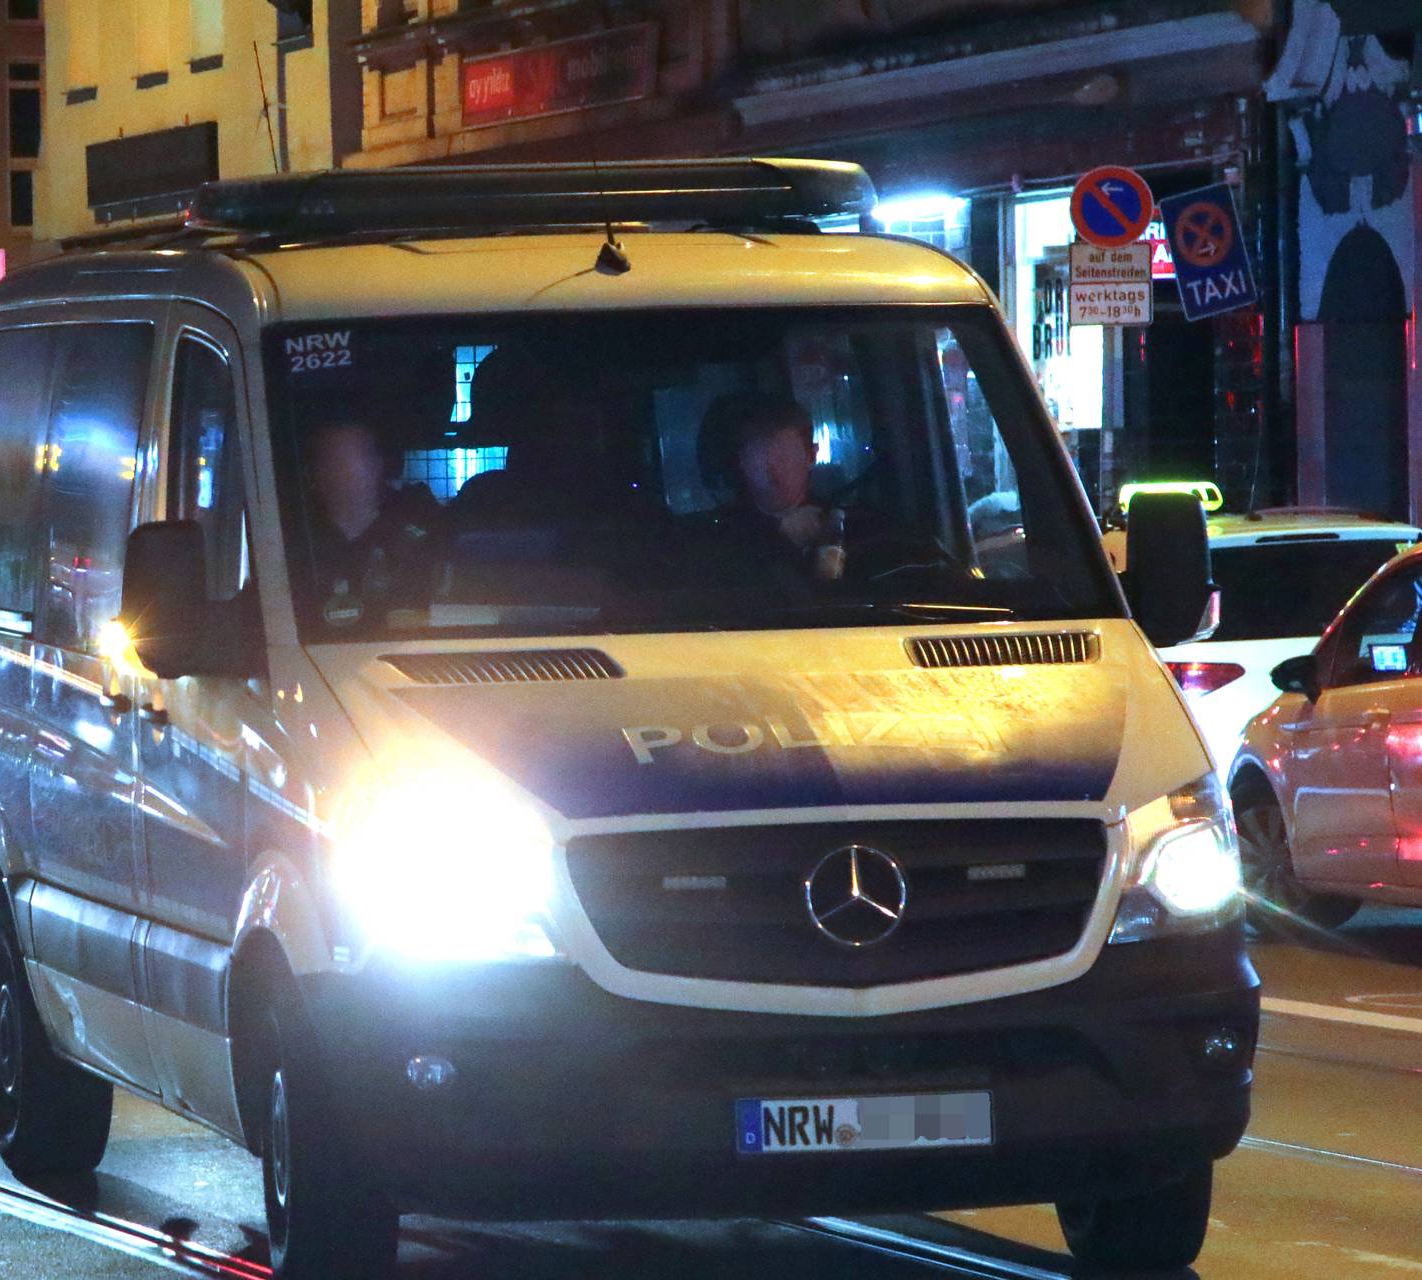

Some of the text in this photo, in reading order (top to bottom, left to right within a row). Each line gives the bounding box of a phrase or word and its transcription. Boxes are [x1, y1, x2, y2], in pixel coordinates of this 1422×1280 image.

[1089, 251, 1133, 263] auf dem
[1075, 264, 1146, 278] Seitenstreifen
[1075, 289, 1146, 305] werktags
[1186, 270, 1247, 307] TAXI
[285, 330, 351, 355] NRW
[290, 350, 353, 373] 2622
[621, 710, 1010, 765] POLIZEI
[763, 1104, 835, 1147] NRW
